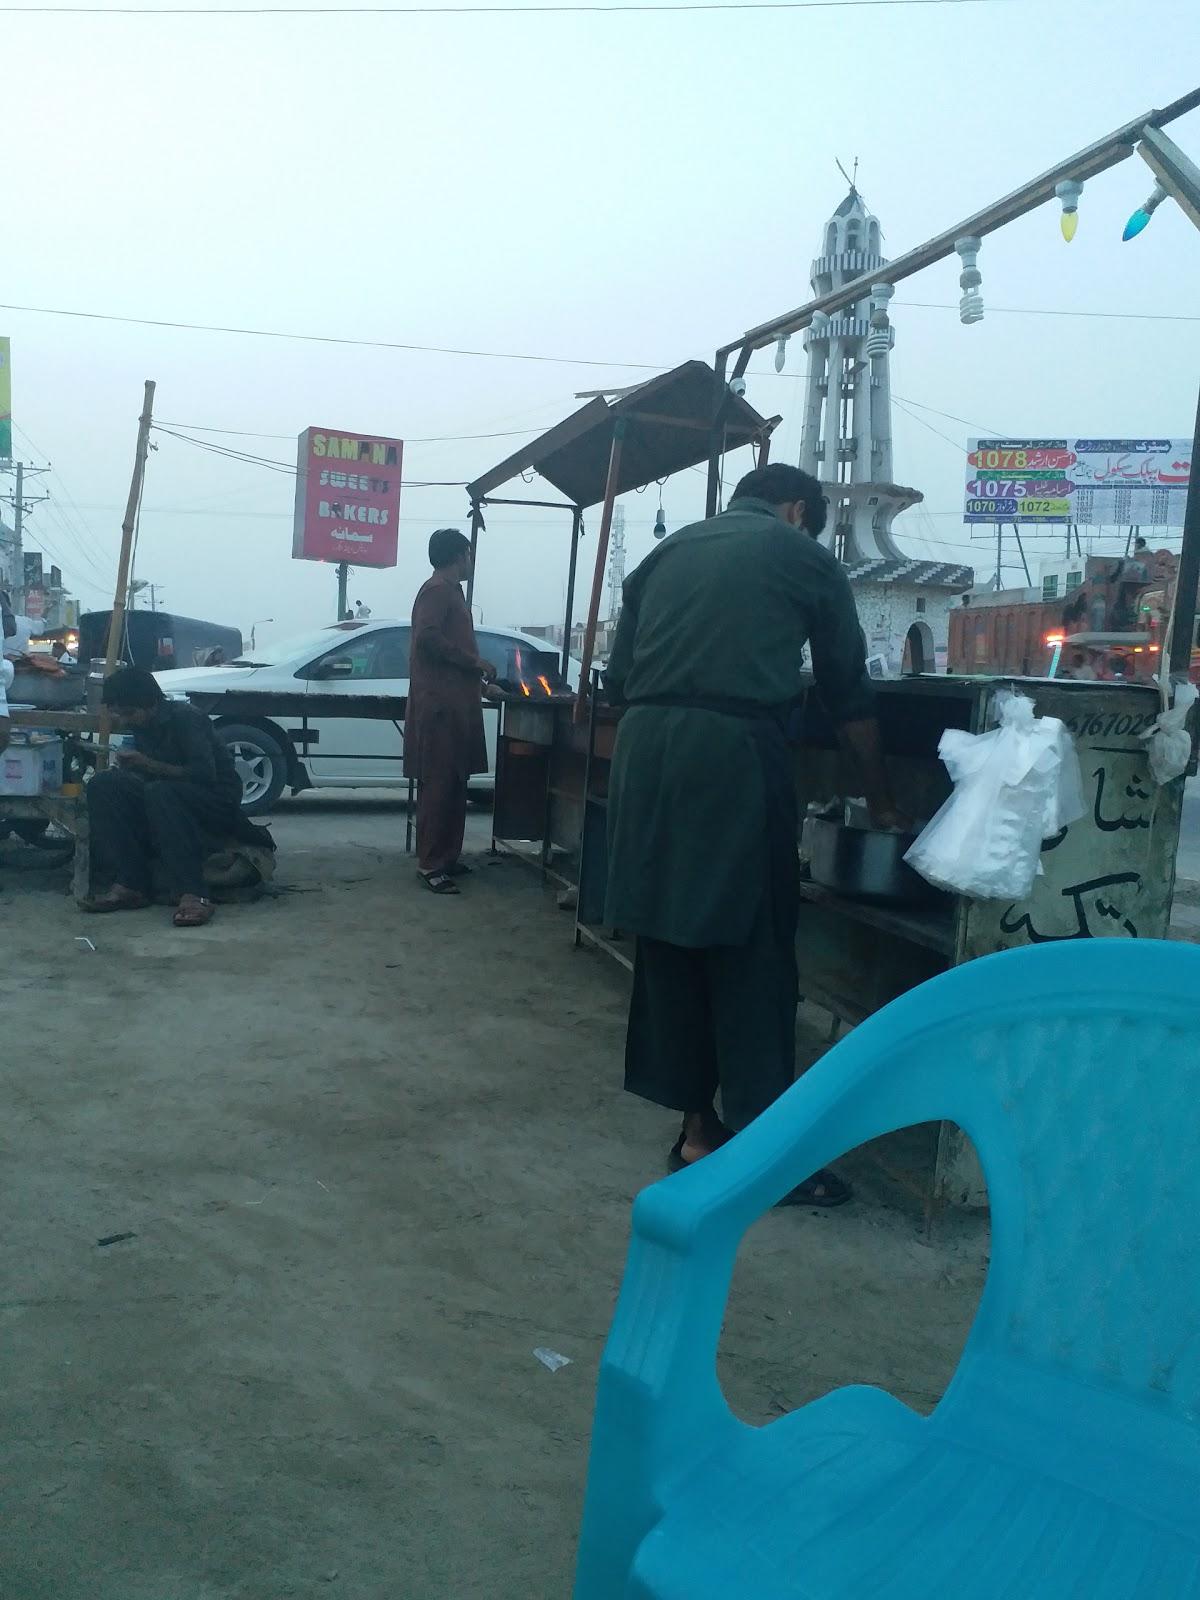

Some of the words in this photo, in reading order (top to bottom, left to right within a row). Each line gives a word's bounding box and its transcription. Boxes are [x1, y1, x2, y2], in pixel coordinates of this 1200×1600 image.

[975, 450, 1028, 469] 1078
[972, 480, 1028, 498] 1075
[318, 501, 389, 526] BAKERS
[967, 500, 996, 512] 1070
[1021, 501, 1050, 512] 1072
[331, 527, 374, 543] سمانہ
